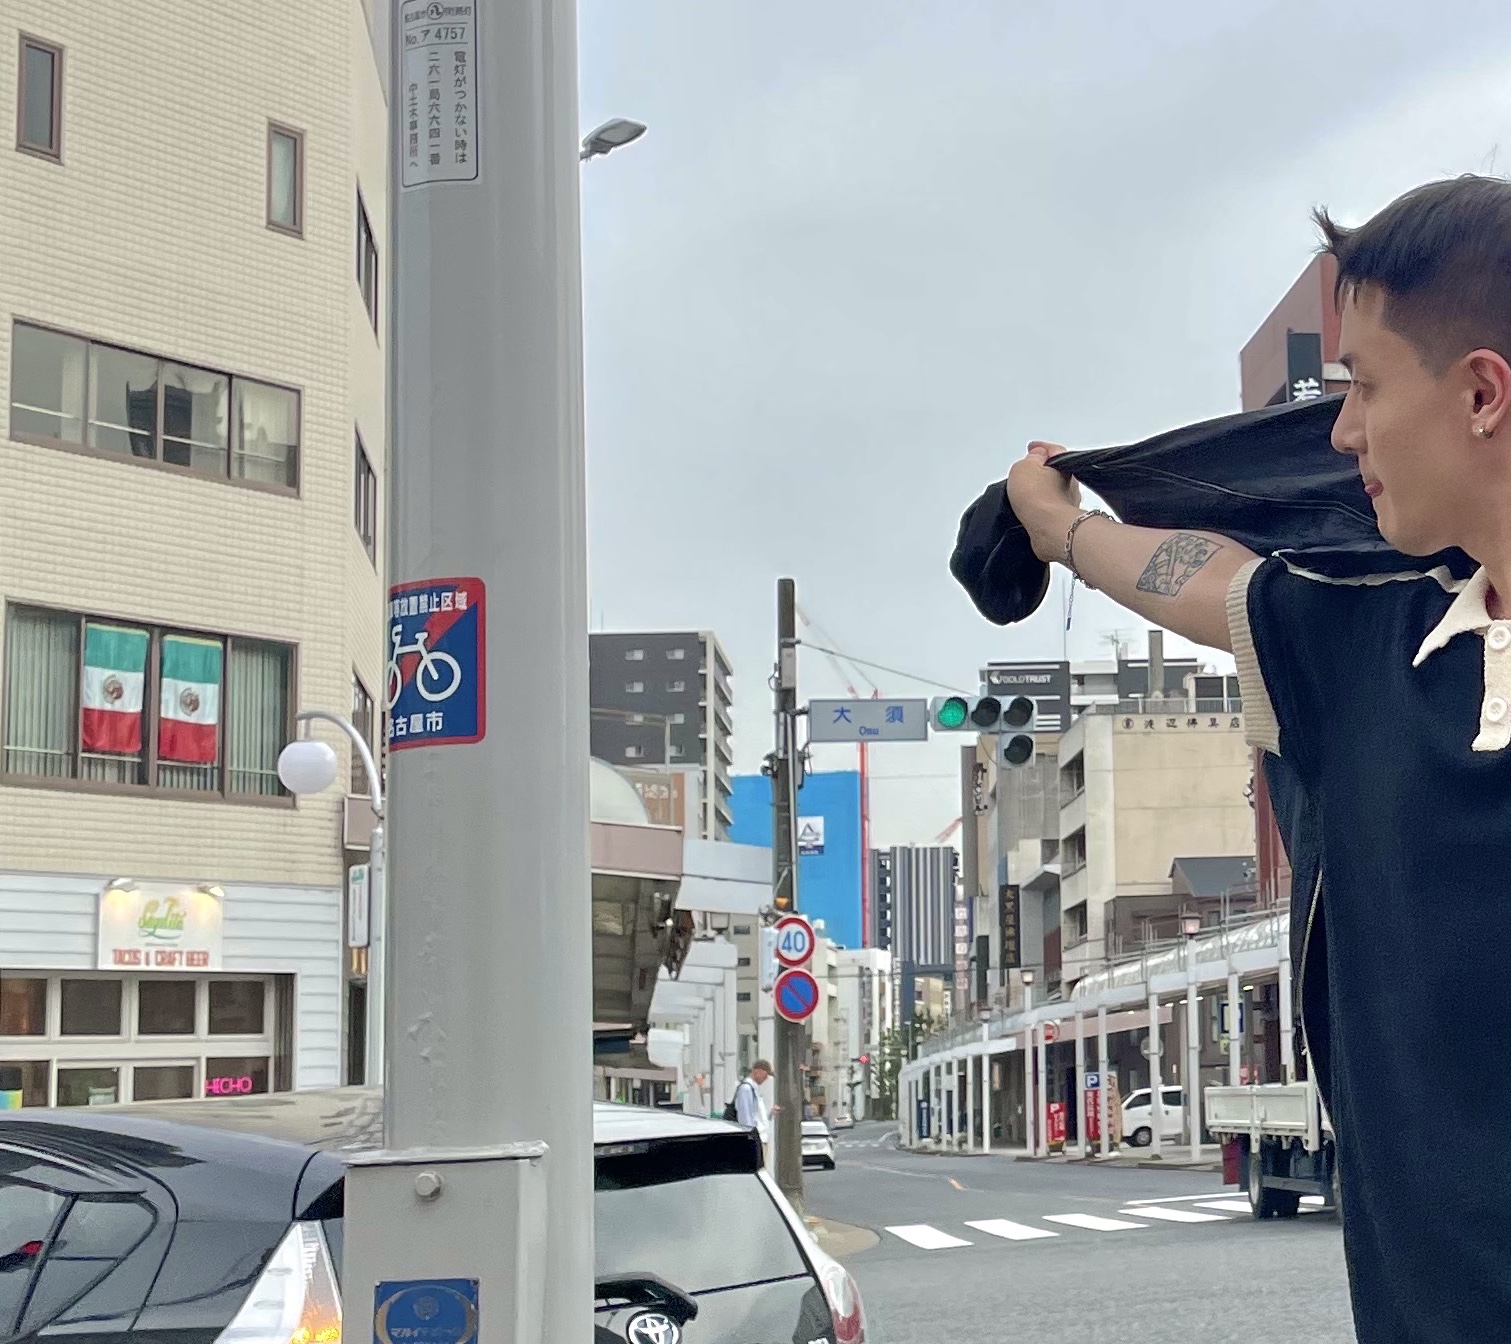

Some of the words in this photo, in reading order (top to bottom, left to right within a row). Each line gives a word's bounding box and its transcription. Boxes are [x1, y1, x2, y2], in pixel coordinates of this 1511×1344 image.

[434, 27, 466, 41] 4757
[833, 706, 904, 724] 大須
[858, 725, 880, 736] Osu
[781, 931, 805, 953] 40
[1086, 1076, 1099, 1088] P
